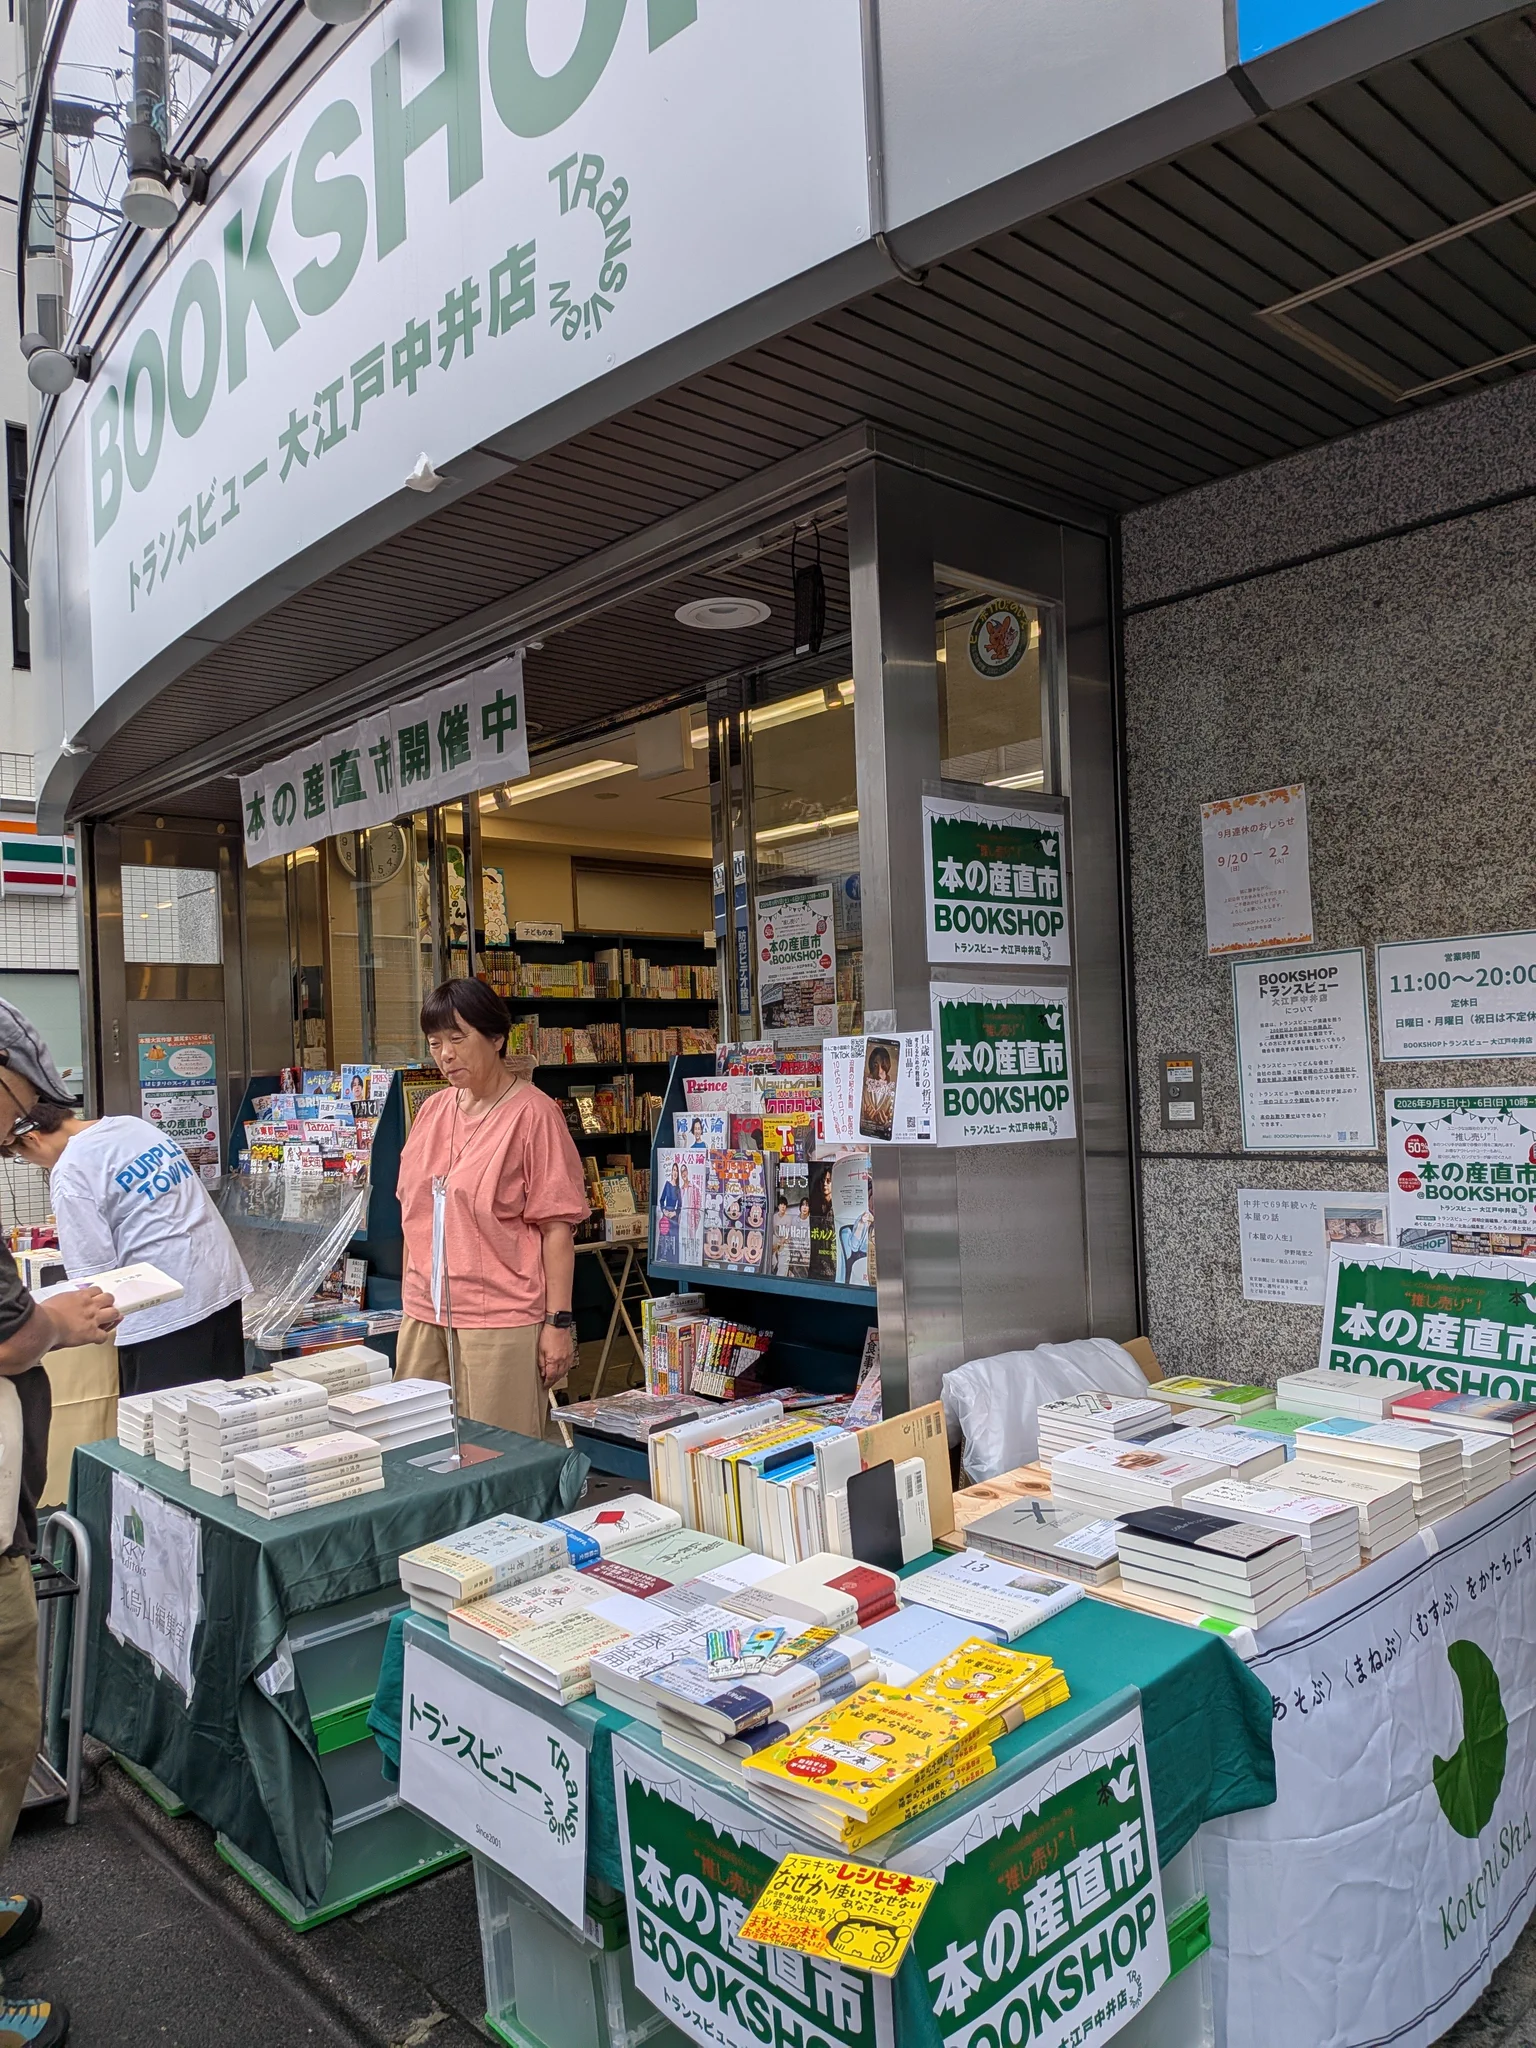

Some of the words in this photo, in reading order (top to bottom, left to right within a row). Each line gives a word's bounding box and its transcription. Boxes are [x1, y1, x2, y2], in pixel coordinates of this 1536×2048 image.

[92, 0, 698, 548] BOOKSHO
[127, 457, 270, 614] トランスビュー
[277, 238, 538, 485] 大江戸中井店
[245, 688, 519, 842] 本の産直市開催中
[1218, 817, 1295, 838] 9月連休のおしらせ
[1217, 853, 1248, 868] 9/20
[937, 856, 1059, 901] 本の産直市
[934, 903, 1064, 937] BOOKSHOP
[523, 928, 555, 937] 子どもの本
[769, 934, 821, 955] 本の産直市
[954, 942, 999, 954] トランスビュー
[1000, 945, 1042, 956] 大江戸中井店
[1444, 950, 1481, 962] 営業時間
[737, 930, 750, 1012] 防犯ビデオ設置
[1259, 967, 1339, 986] BOOKSHOP
[1259, 983, 1339, 999] トランスビュー
[1285, 1006, 1314, 1015] について
[1450, 998, 1478, 1008] 定休日
[1490, 1036, 1533, 1046] 大江戸中井店
[946, 1039, 1064, 1077] 本の産直市
[686, 1078, 728, 1095] Prince
[943, 1084, 1070, 1117] BOOKSHOP
[156, 1118, 207, 1129] 本の産直市
[676, 1117, 724, 1134] 婦公論
[963, 1125, 1007, 1137] トランスビュー
[1008, 1121, 1048, 1133] 大江戸中井店
[115, 1139, 183, 1193] PURPLE
[674, 1153, 706, 1165] 婦人公論
[137, 1159, 193, 1201] TOWN
[1417, 1161, 1536, 1185] 本の産直市
[1243, 1199, 1318, 1211] 中井で69年続いた
[1440, 1204, 1478, 1213] トランスビュー
[1244, 1212, 1280, 1222] 本屋の話
[1247, 1232, 1293, 1242] 『本屋の人生』
[1338, 1302, 1536, 1367] 本の産直市
[122, 1540, 145, 1563] KKY
[121, 1556, 147, 1578] ditors
[960, 1558, 992, 1574] 13
[408, 1692, 544, 1795] トランスビュー
[823, 1743, 872, 1766] サイン本
[475, 1822, 502, 1849] Since2001
[773, 1869, 922, 1910] なぜか使いこなせない
[749, 1914, 821, 1940] まずはこの本を
[927, 1816, 1145, 2018] 本の産直市
[635, 1905, 832, 2048] BOOKSH
